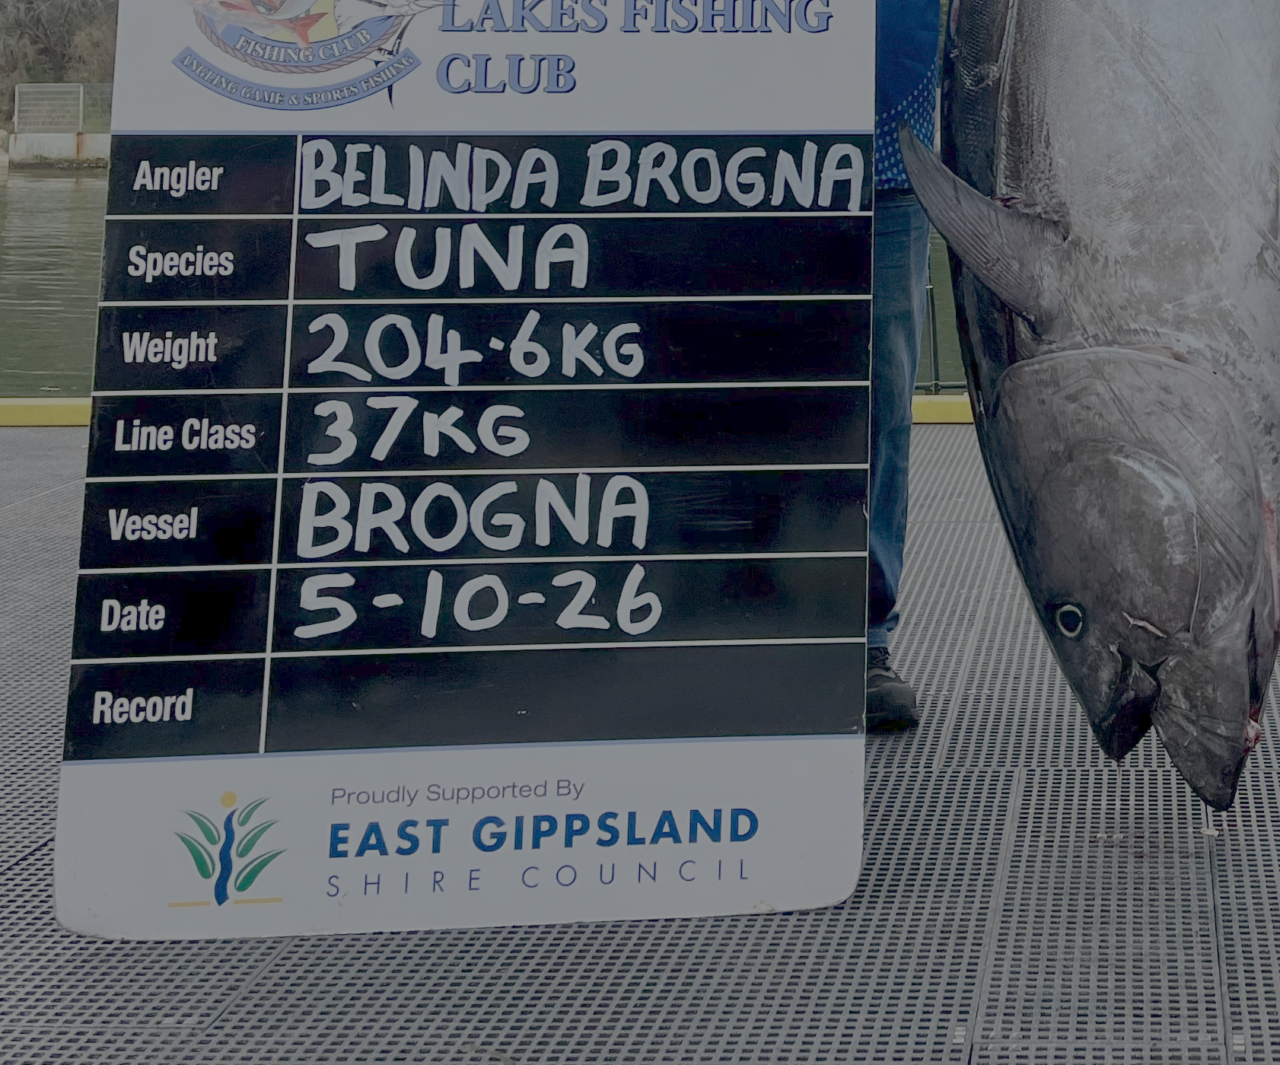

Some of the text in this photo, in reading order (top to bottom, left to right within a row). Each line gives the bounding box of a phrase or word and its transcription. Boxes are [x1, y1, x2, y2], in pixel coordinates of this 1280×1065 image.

[234, 28, 373, 63] FISHING CLUB
[180, 53, 415, 106] ANGLING GAME & SPORTS FISHING
[436, 53, 577, 94] CLUB
[133, 160, 224, 198] Angler
[301, 139, 865, 213] BELINDA BROGNA
[128, 245, 234, 283] Species
[304, 223, 590, 292] TUNA
[122, 331, 218, 369] Weight
[114, 418, 256, 451] Line Class
[307, 395, 531, 466] 37KG
[109, 506, 198, 541] Vessel
[296, 473, 650, 558] BROGNA
[100, 599, 166, 632] Date
[293, 563, 663, 638] 5-10-26
[93, 688, 194, 724] Record
[331, 779, 585, 807] Proudly Supported By
[328, 808, 760, 859] EAST GIPPSLAND
[326, 859, 749, 898] SHIRE COUNCIL
